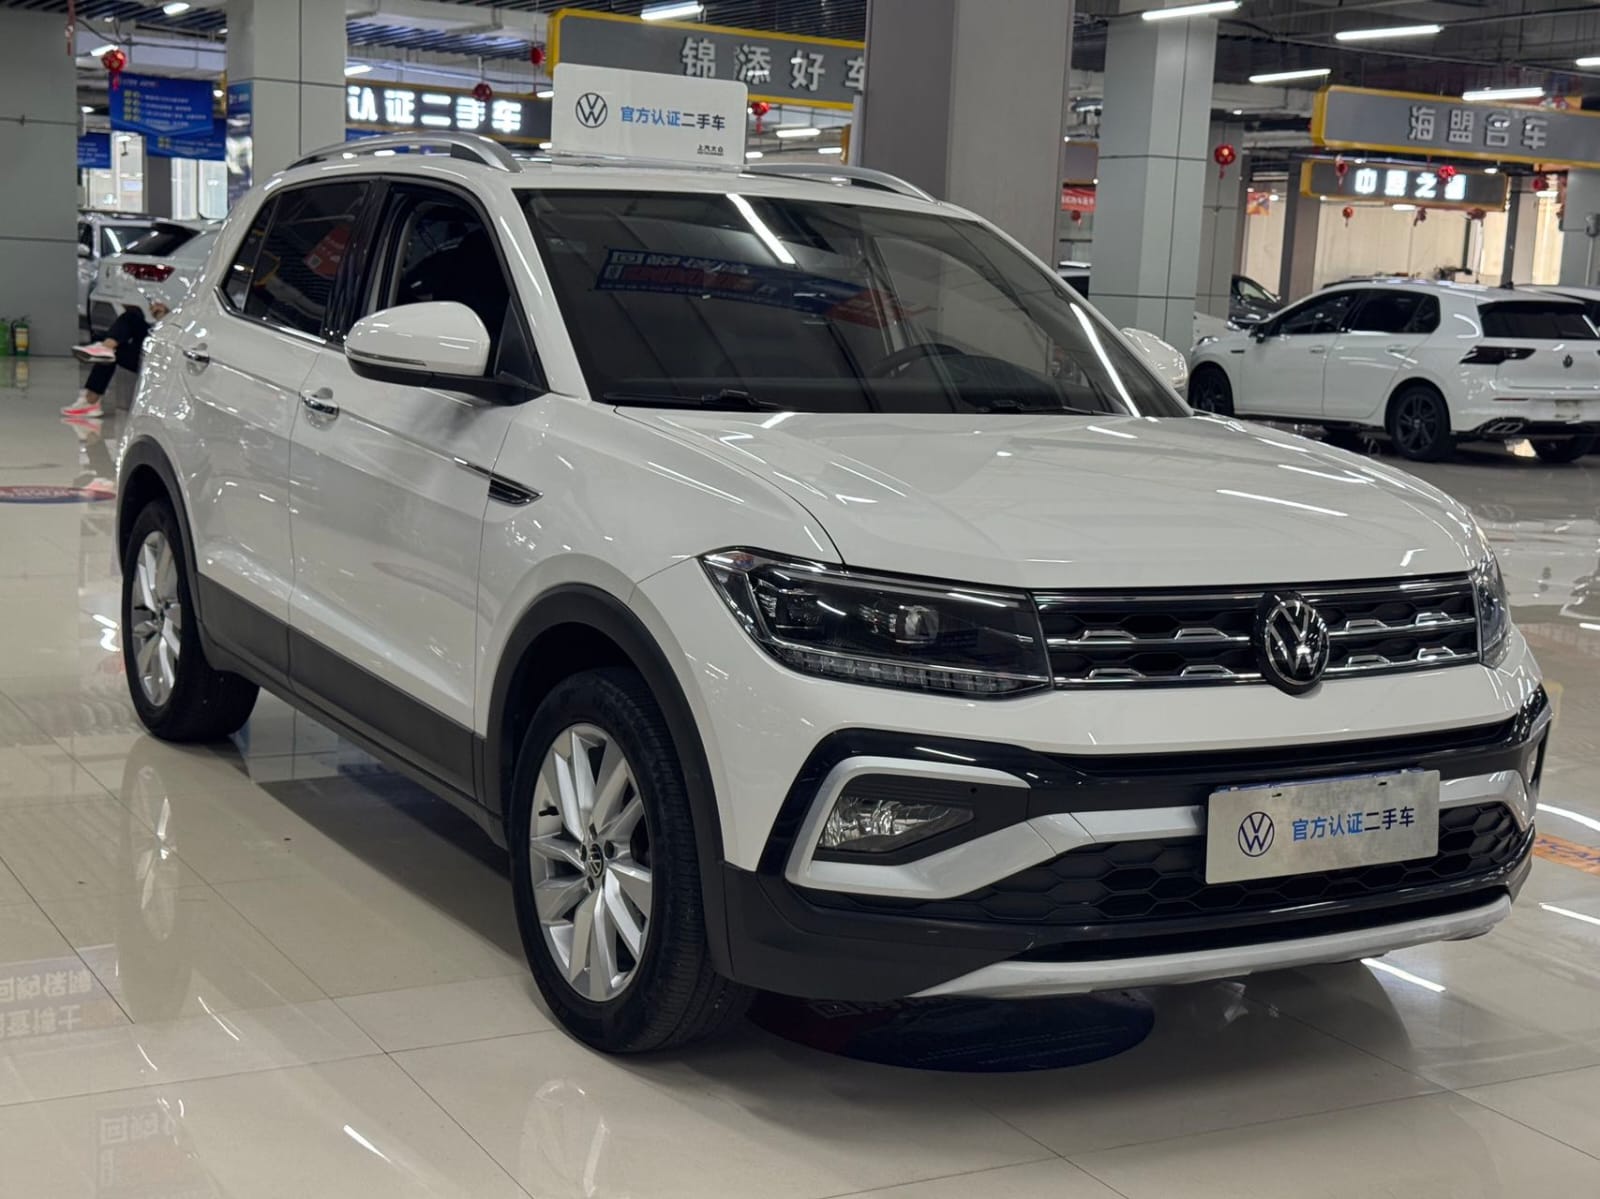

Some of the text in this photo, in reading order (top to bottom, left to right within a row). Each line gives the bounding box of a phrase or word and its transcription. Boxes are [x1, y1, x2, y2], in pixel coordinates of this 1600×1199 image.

[347, 85, 522, 133] 认证二手车
[621, 106, 725, 130] 官方认证二手车
[1291, 806, 1415, 842] 官方认证二手车
